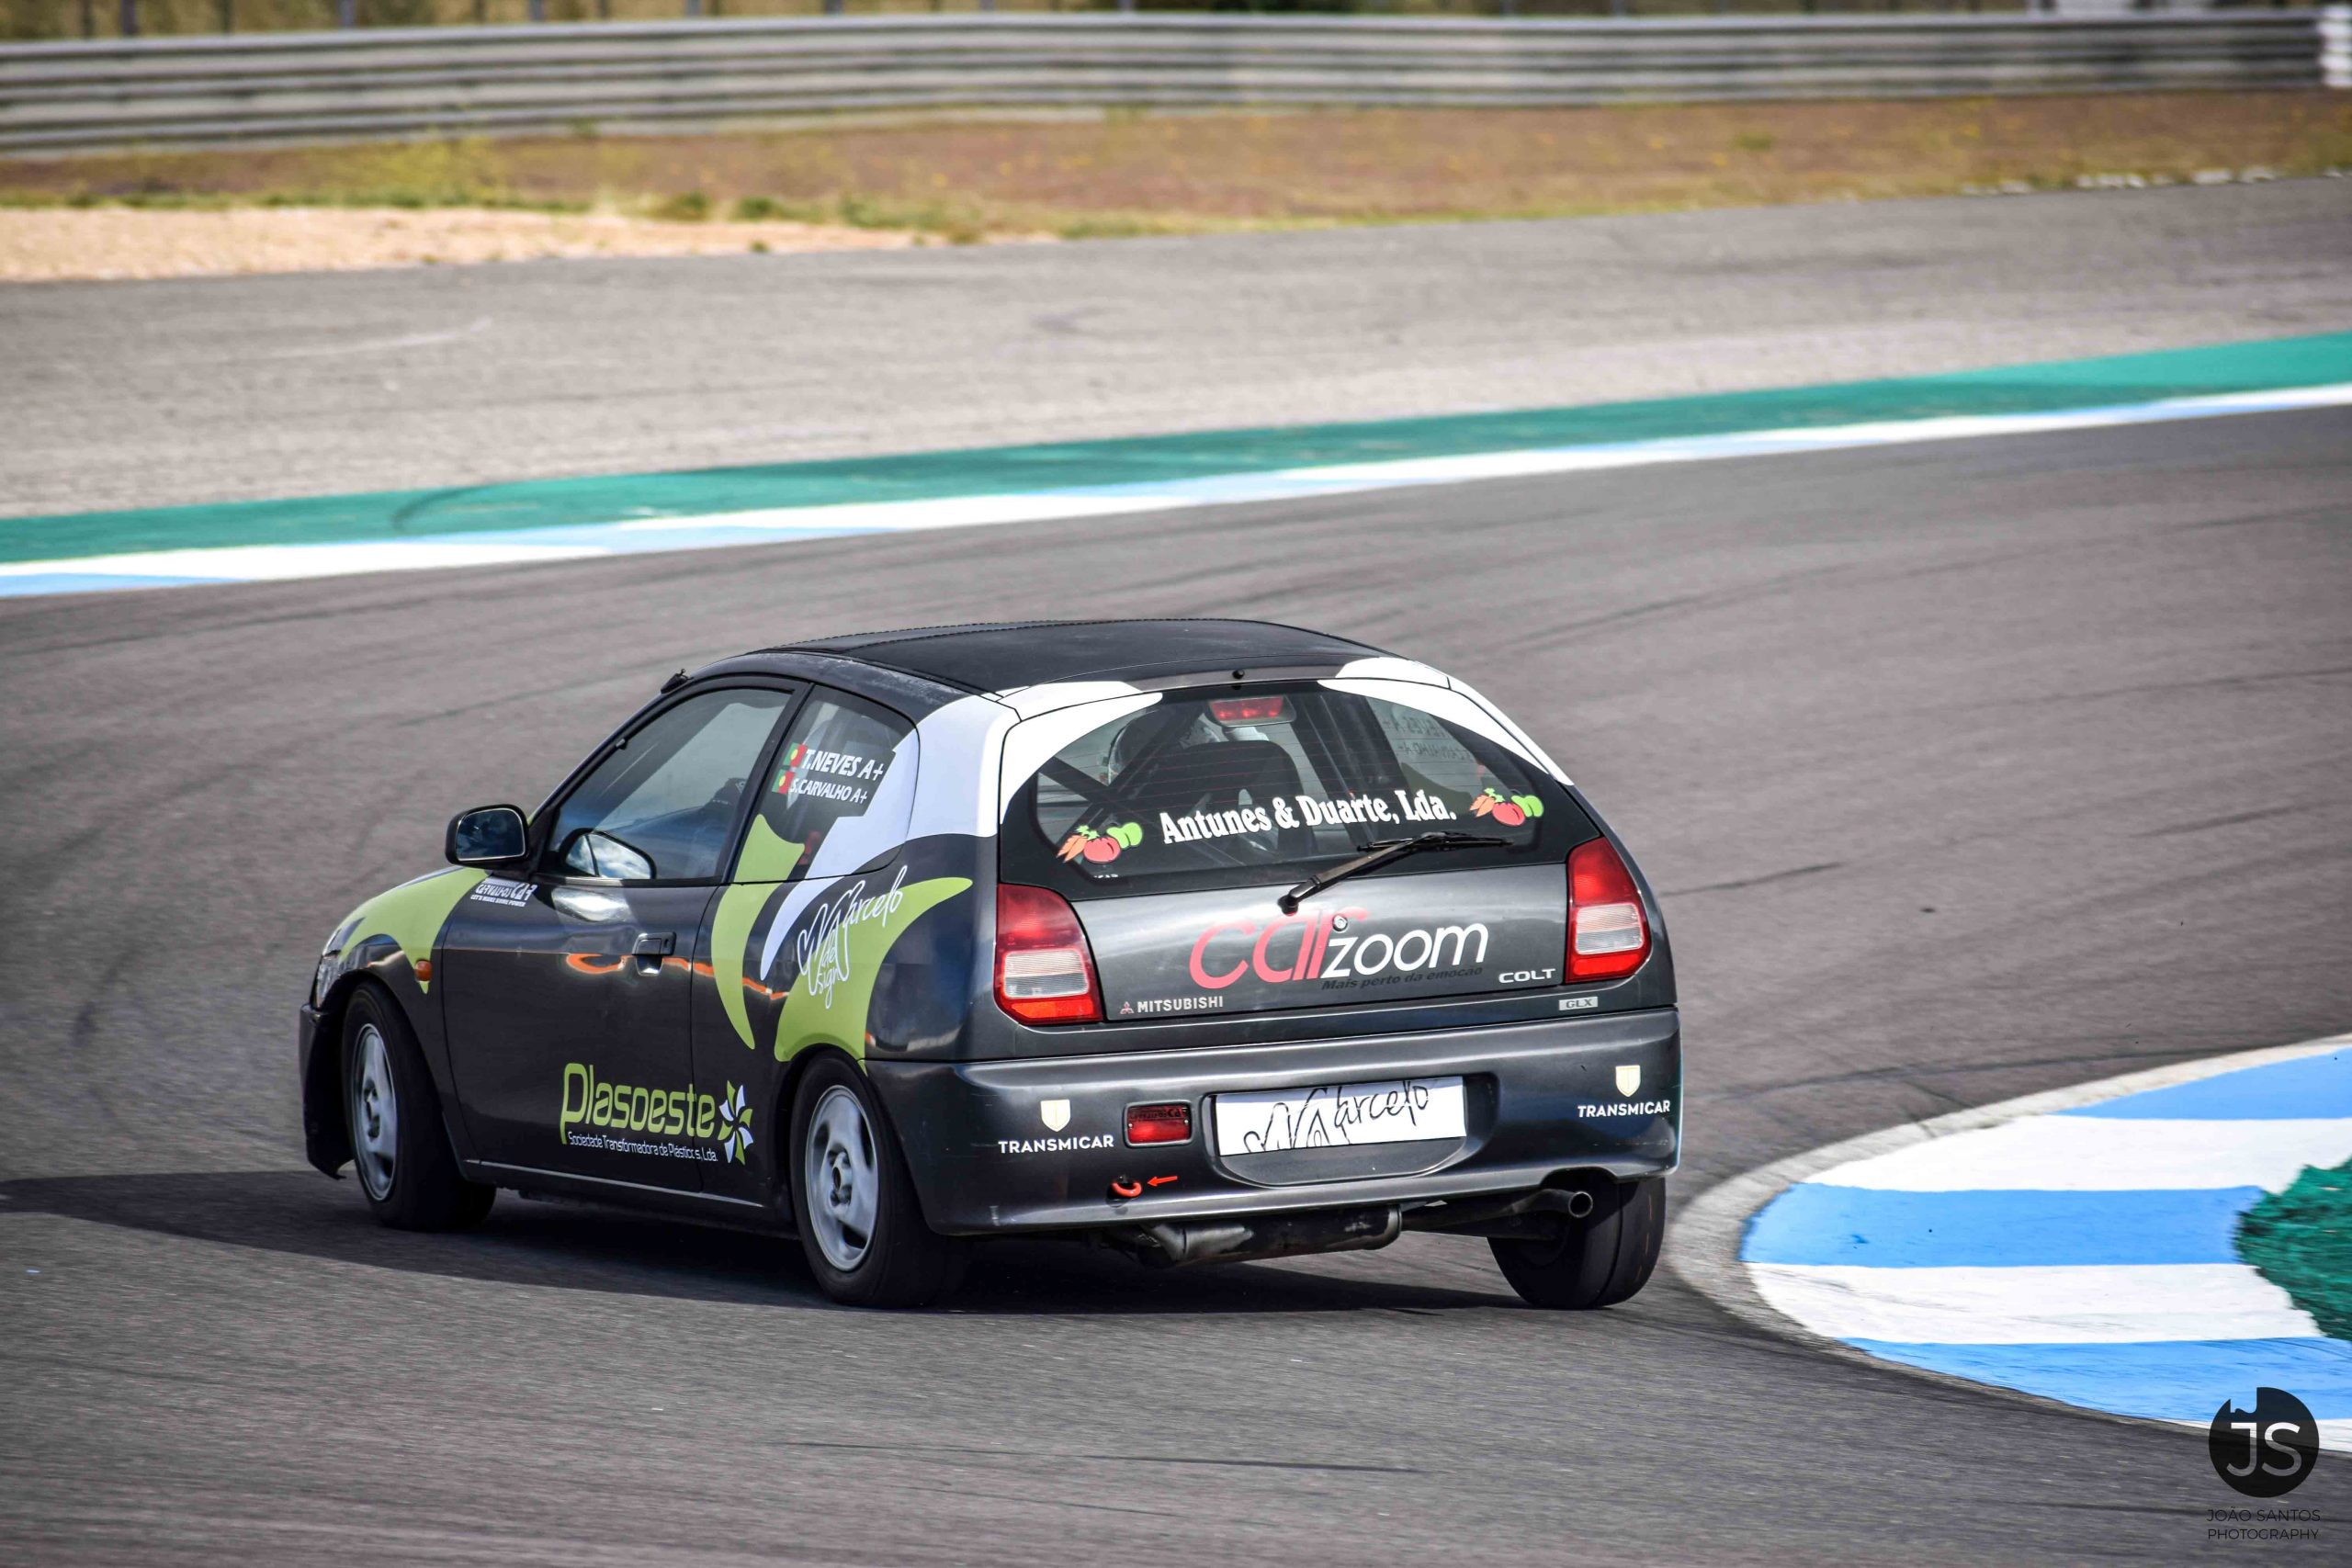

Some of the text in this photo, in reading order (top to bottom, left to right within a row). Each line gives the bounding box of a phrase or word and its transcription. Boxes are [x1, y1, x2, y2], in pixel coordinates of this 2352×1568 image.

[802, 750, 883, 781] T.NEVES A+
[790, 779, 867, 805] S.CARVALHO A+
[1160, 788, 1457, 844] Antunes & Duarte, Lda.
[1321, 978, 1358, 991] Mais
[1360, 974, 1402, 990] perto
[1403, 972, 1423, 983] da
[1498, 968, 1557, 985] COLT
[1137, 996, 1224, 1013] MITSUBISHI
[1566, 998, 1593, 1010] GLX
[560, 1063, 716, 1145] Plasoeste
[1577, 1100, 1672, 1118] TRANSMICAR
[568, 1131, 603, 1149] Sociedade
[602, 1134, 659, 1156] Transformadora
[658, 1142, 668, 1157] de
[701, 1146, 718, 1162] Lda.
[998, 1134, 1114, 1155] TRANSMICAR
